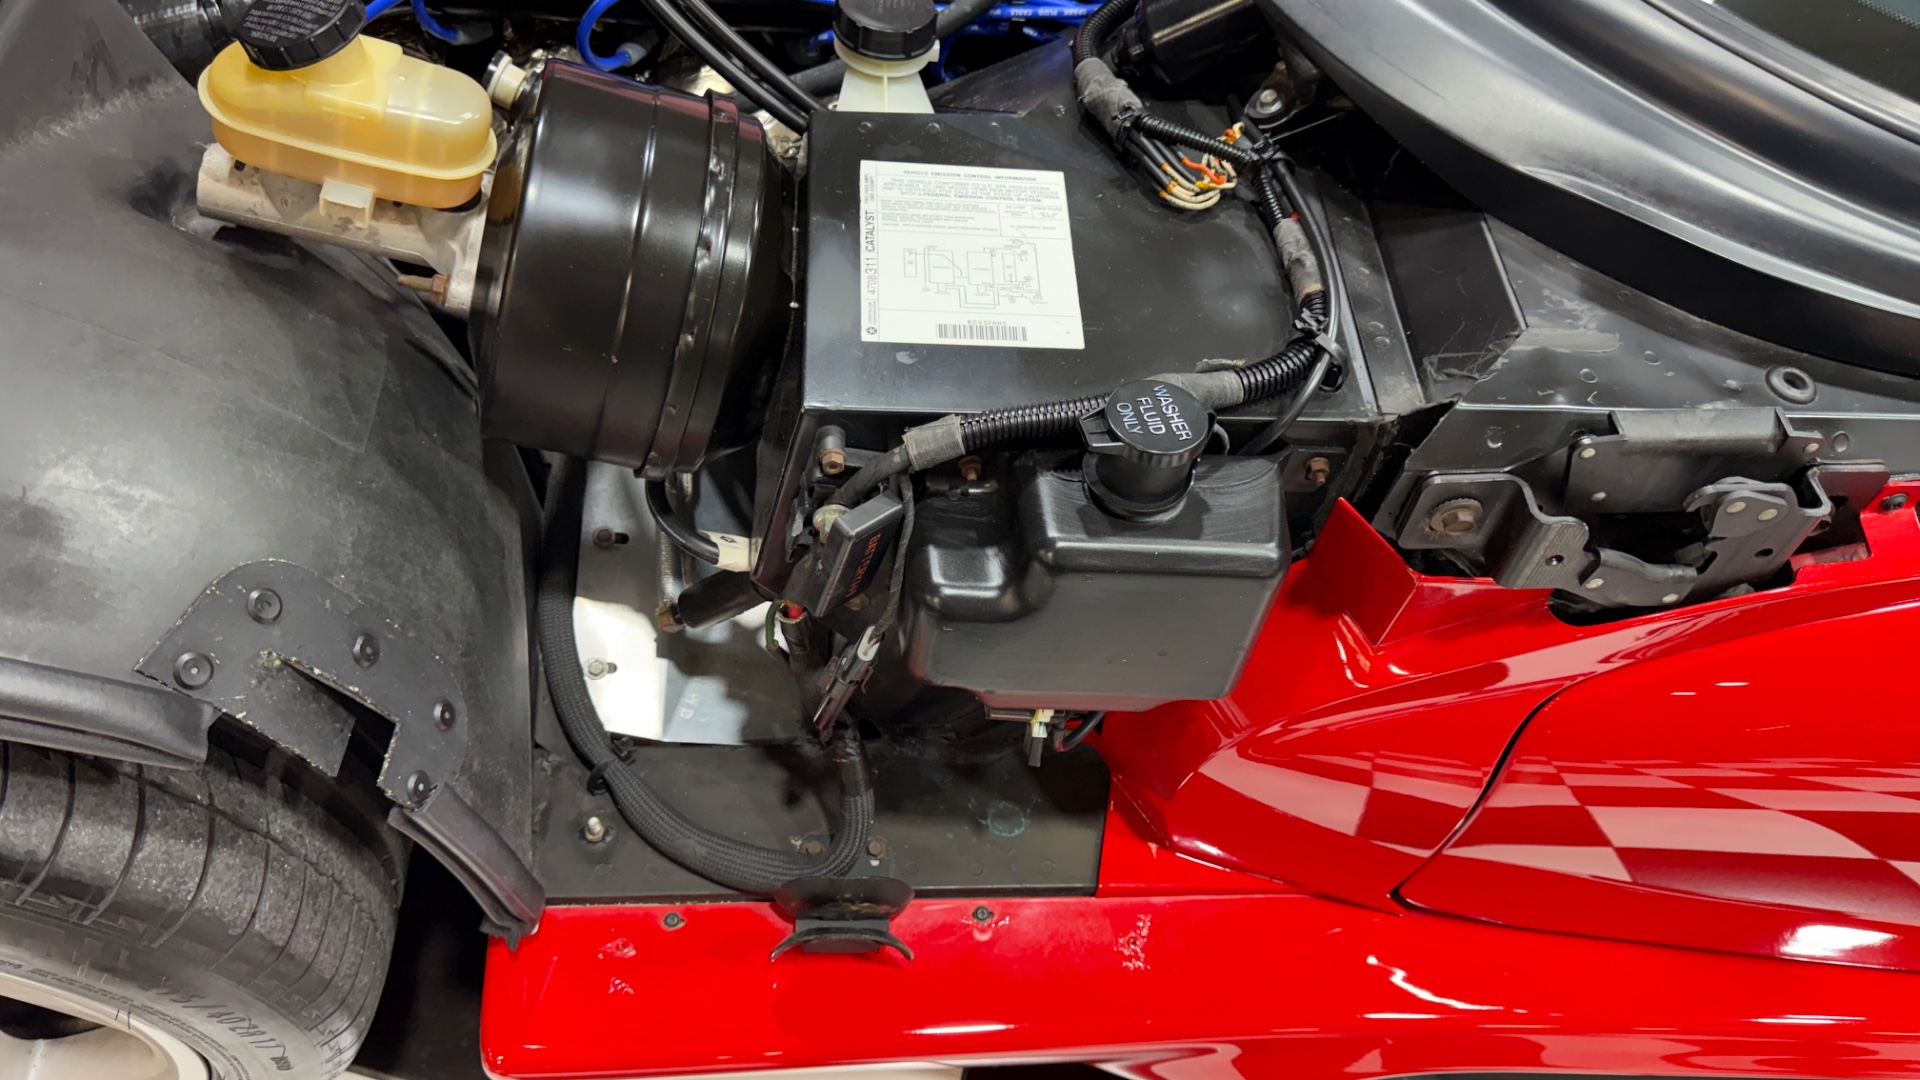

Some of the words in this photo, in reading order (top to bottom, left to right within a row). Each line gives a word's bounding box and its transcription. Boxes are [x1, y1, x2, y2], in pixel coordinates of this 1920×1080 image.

[865, 210, 875, 252] CATALYST
[865, 258, 877, 295] 4708311
[1116, 402, 1144, 434] ONLY
[1136, 396, 1166, 435] FLUID
[1152, 384, 1192, 441] WASHER
